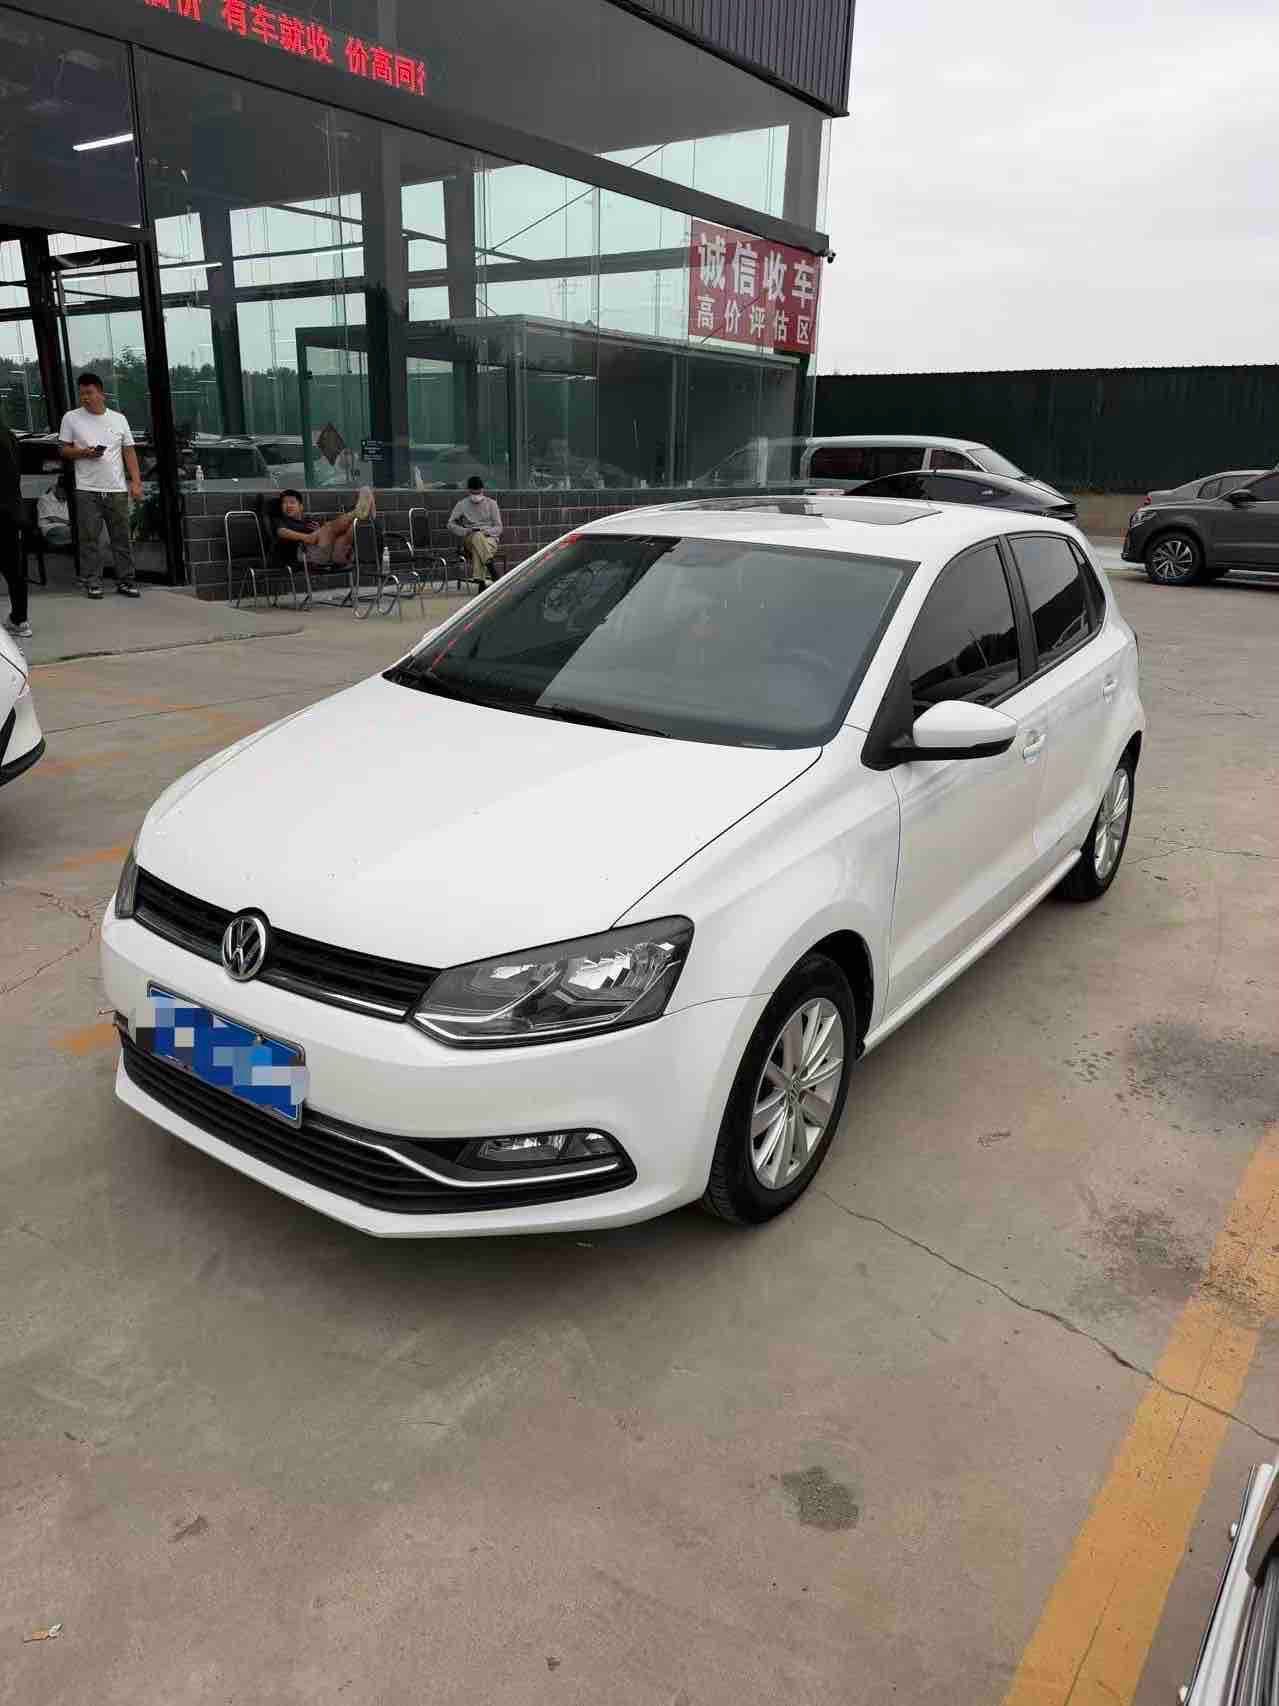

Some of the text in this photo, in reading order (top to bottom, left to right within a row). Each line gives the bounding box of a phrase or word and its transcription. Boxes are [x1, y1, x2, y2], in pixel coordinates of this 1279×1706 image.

[698, 232, 816, 309] 诚信收车
[697, 294, 811, 345] 高价评估区
